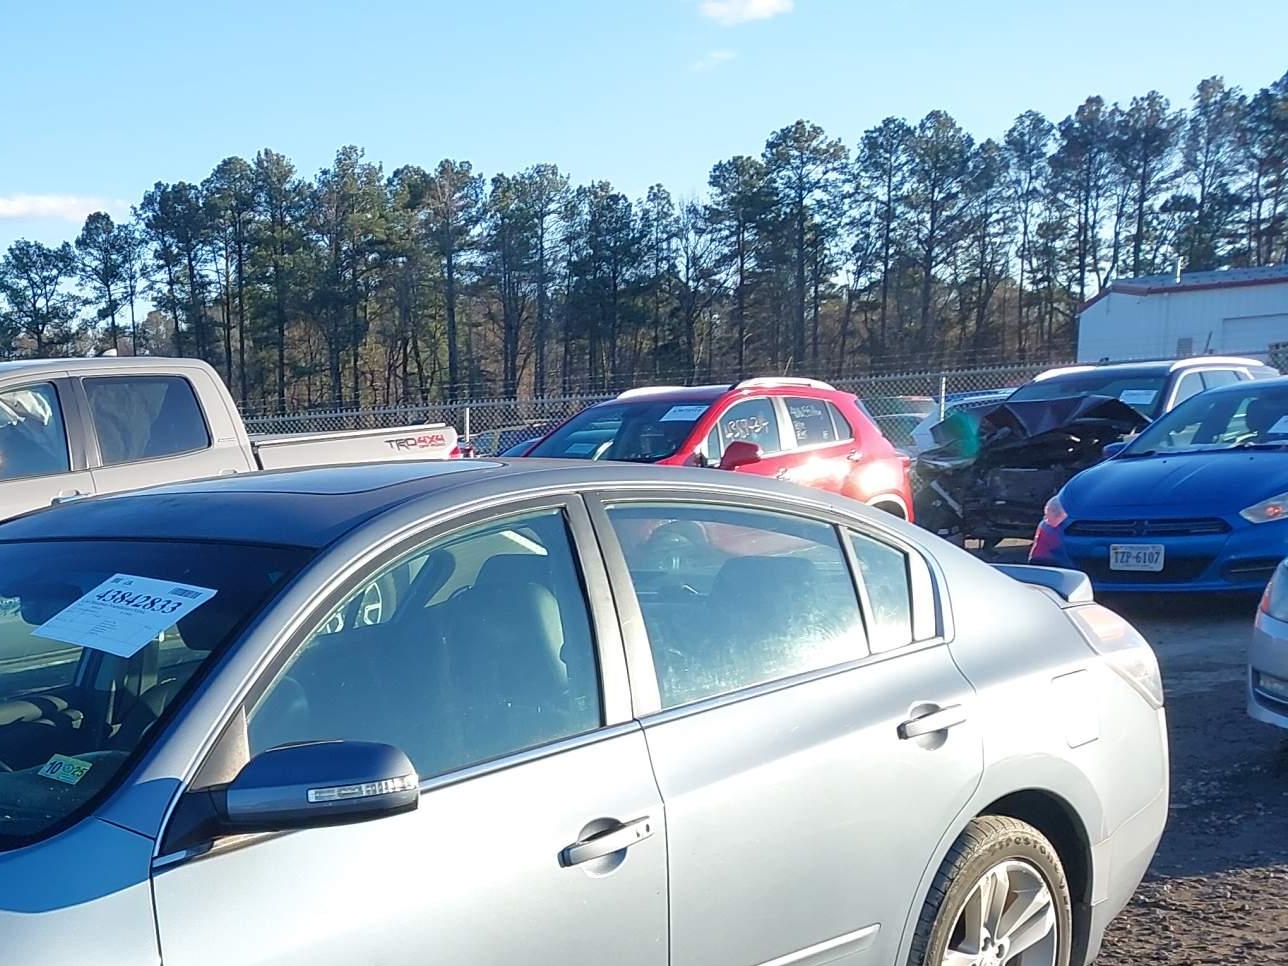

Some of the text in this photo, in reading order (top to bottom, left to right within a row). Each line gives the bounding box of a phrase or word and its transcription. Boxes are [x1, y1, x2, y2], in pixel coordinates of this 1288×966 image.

[384, 438, 417, 451] TRD
[1113, 552, 1160, 564] TZP-6107
[96, 588, 183, 614] 43842833
[46, 760, 88, 777] 10 25
